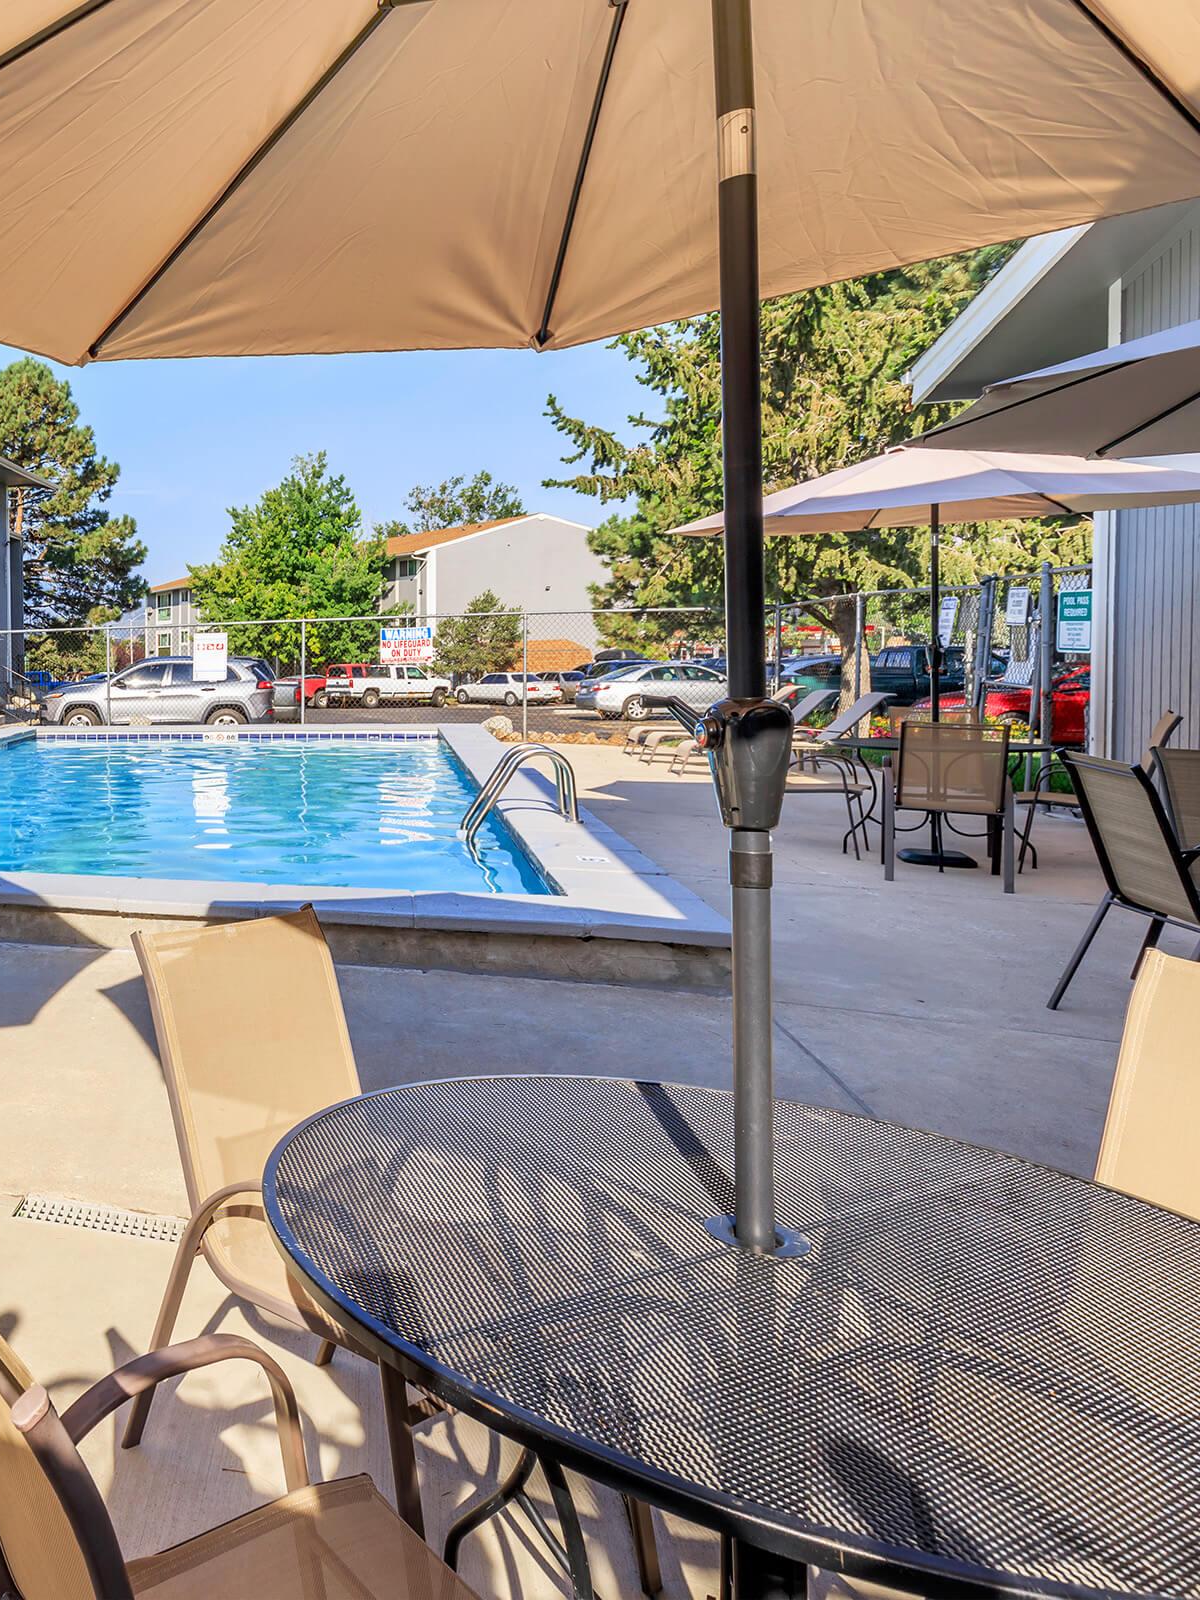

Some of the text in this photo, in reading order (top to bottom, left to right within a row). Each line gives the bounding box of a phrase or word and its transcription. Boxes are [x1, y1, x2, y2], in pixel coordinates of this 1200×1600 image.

[384, 628, 429, 640] WARNING
[381, 639, 431, 649] NO LIFEGUARD
[392, 648, 421, 657] ON DUTY
